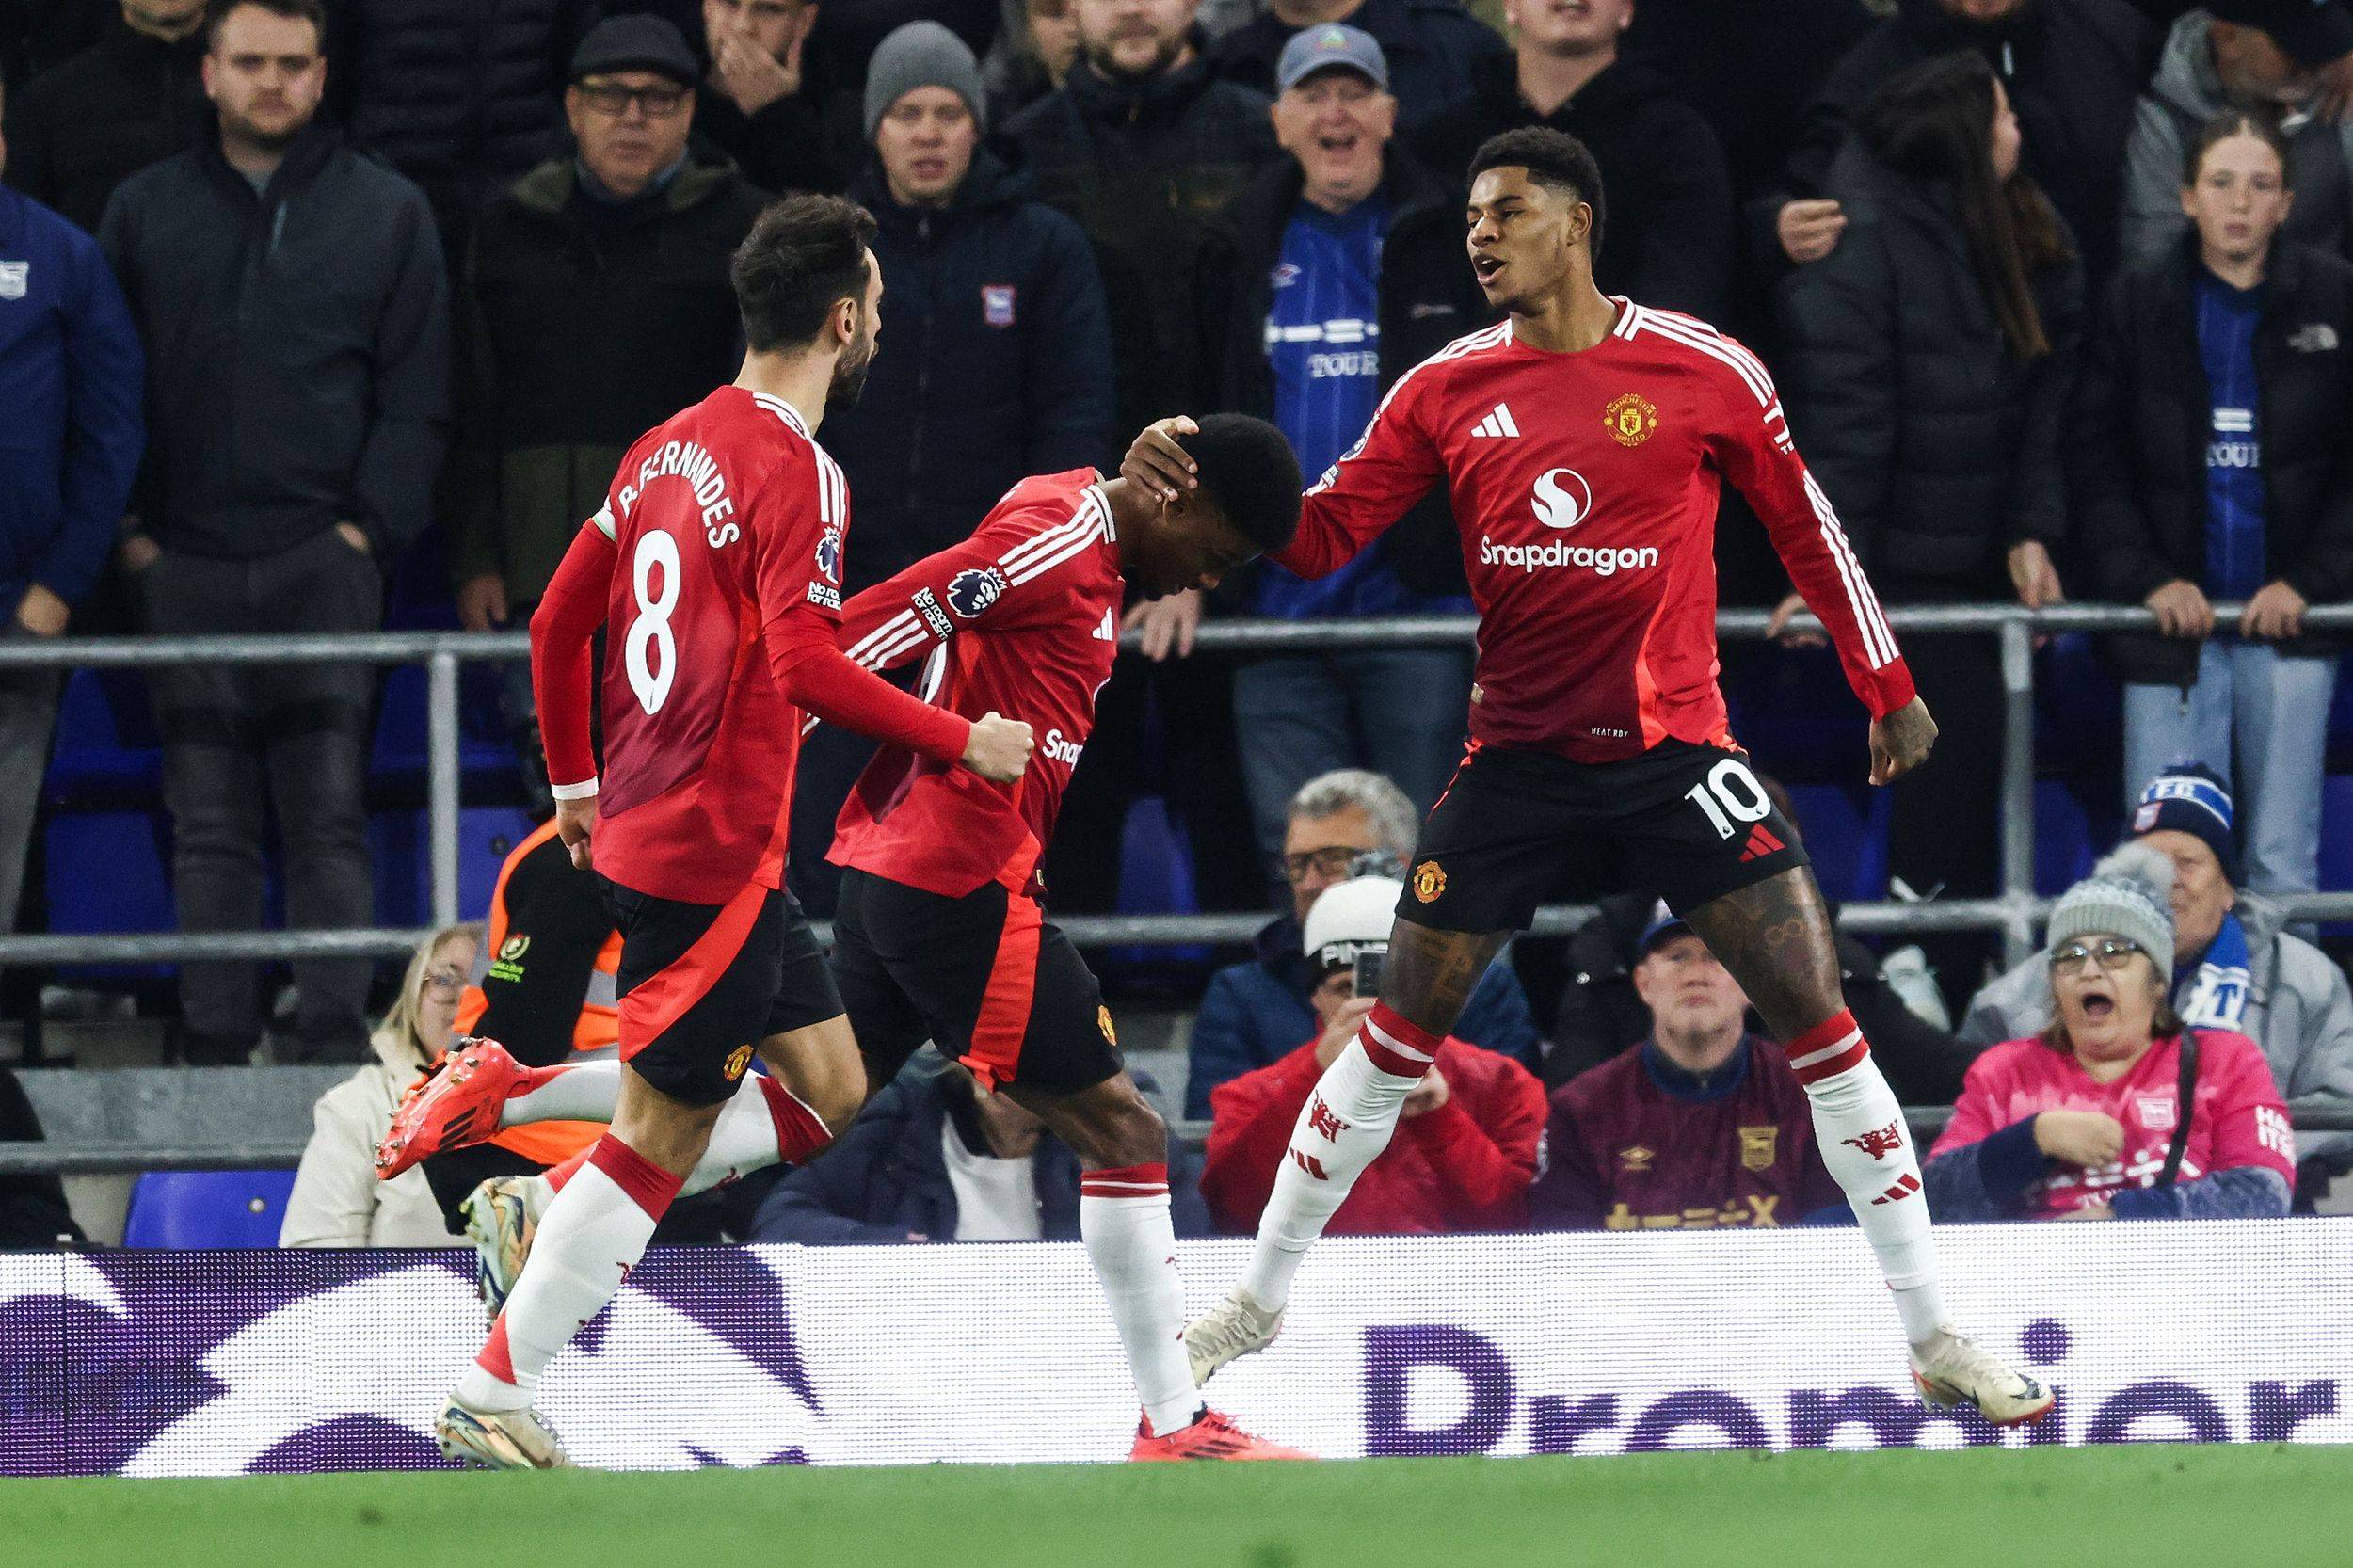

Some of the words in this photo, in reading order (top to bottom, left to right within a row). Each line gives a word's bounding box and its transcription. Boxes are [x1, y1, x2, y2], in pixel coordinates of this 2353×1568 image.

[639, 440, 741, 549] FERNANDES
[1480, 534, 1659, 577] Snapdragon
[625, 529, 680, 716] 8
[930, 602, 953, 633] room
[1591, 727, 1611, 736] HEAT
[1684, 758, 1771, 840] 10
